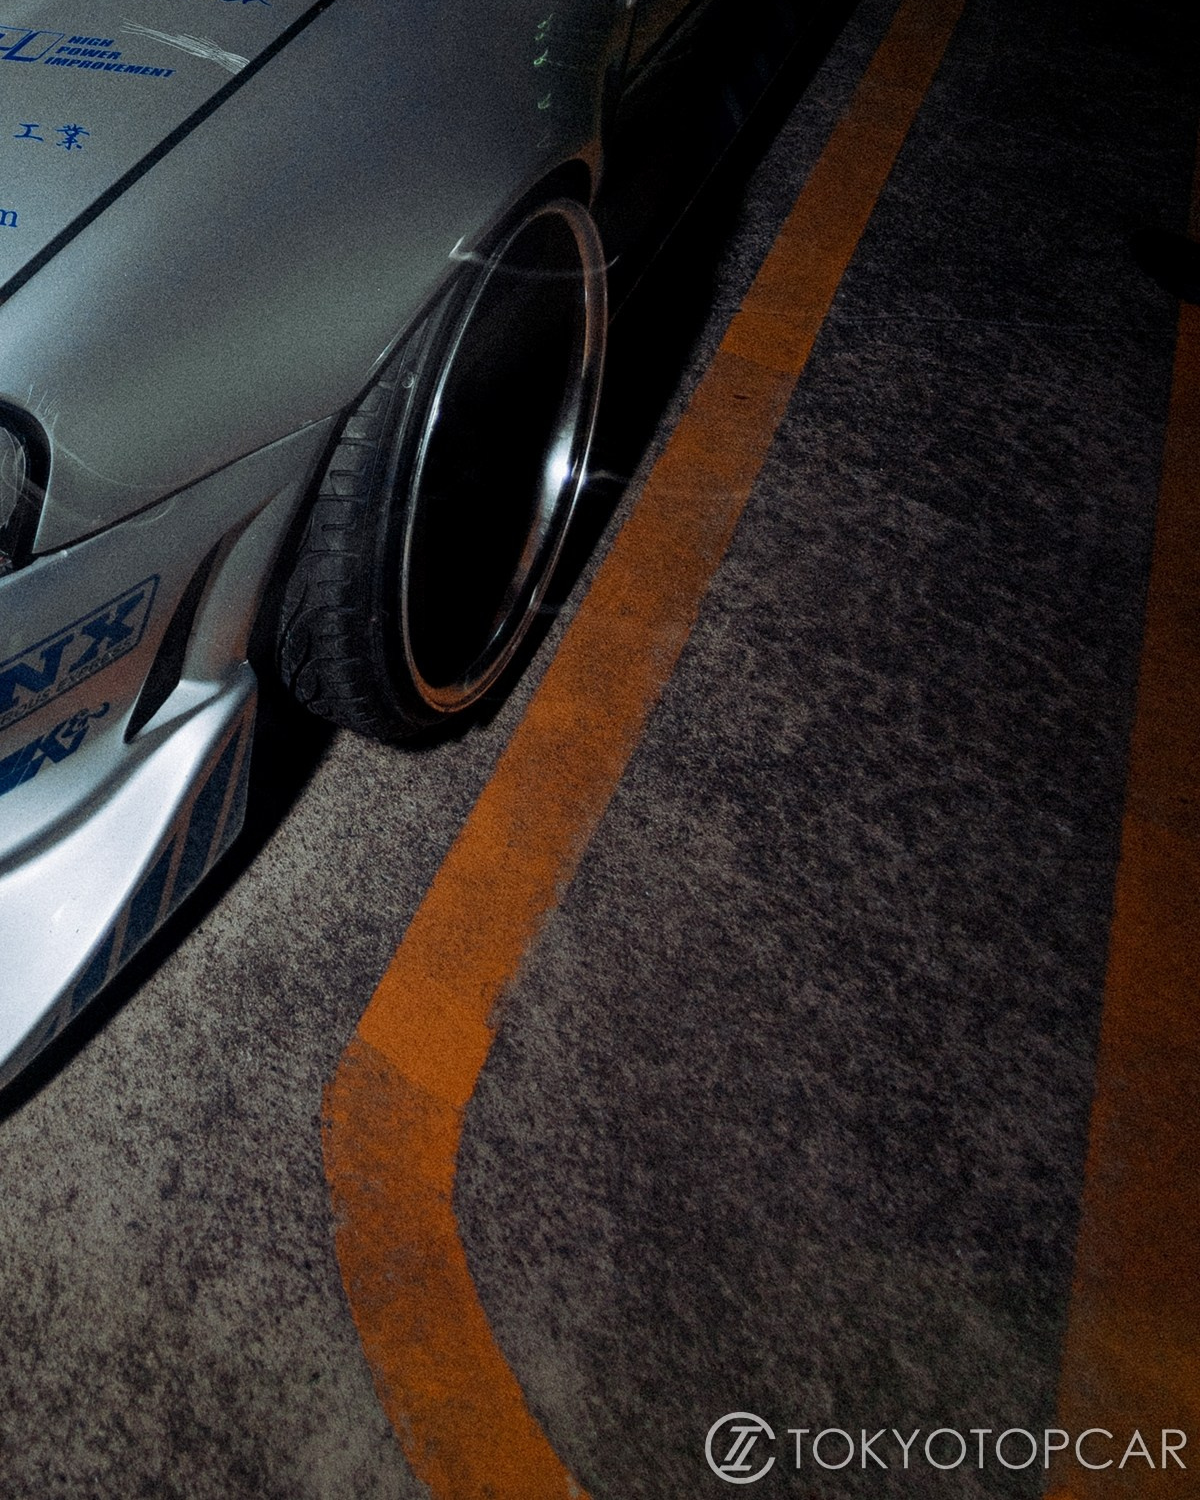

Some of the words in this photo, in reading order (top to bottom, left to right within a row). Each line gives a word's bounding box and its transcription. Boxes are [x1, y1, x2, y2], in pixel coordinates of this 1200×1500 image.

[68, 35, 115, 48] HIGH
[56, 46, 122, 60] POWER
[44, 56, 177, 79] IMPROVEMENT
